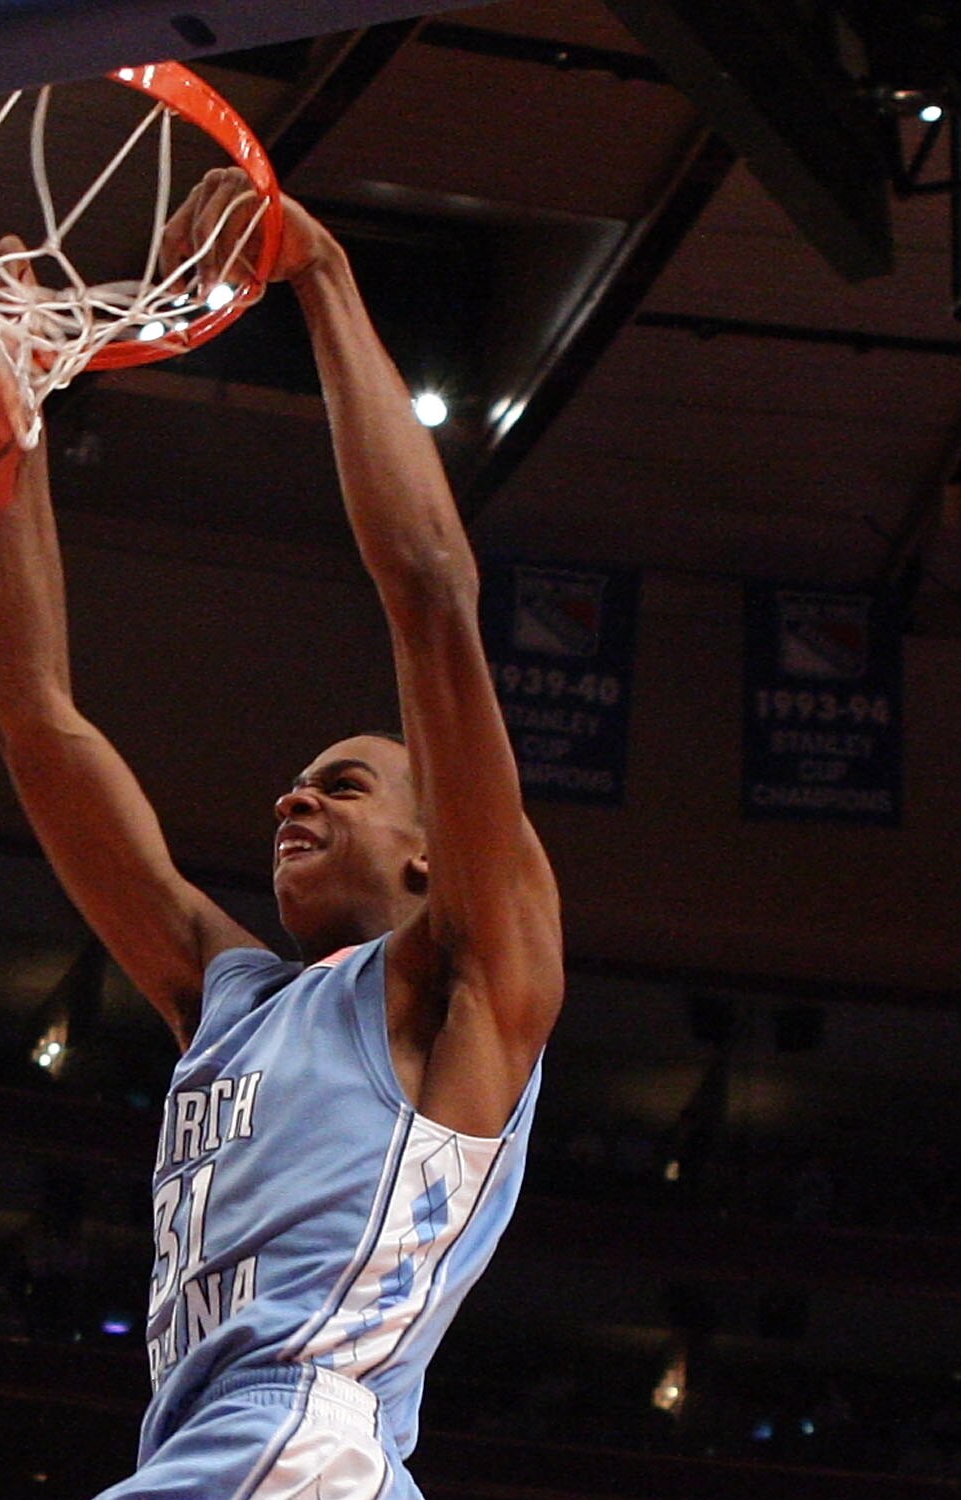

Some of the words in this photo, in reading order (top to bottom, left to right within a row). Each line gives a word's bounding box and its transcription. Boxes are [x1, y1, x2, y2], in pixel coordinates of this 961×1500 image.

[756, 689, 892, 725] 1993-94
[770, 729, 874, 759] STANLEY
[798, 759, 849, 782] CUP
[752, 783, 894, 812] CHAMPIONS
[148, 1161, 216, 1318] 31
